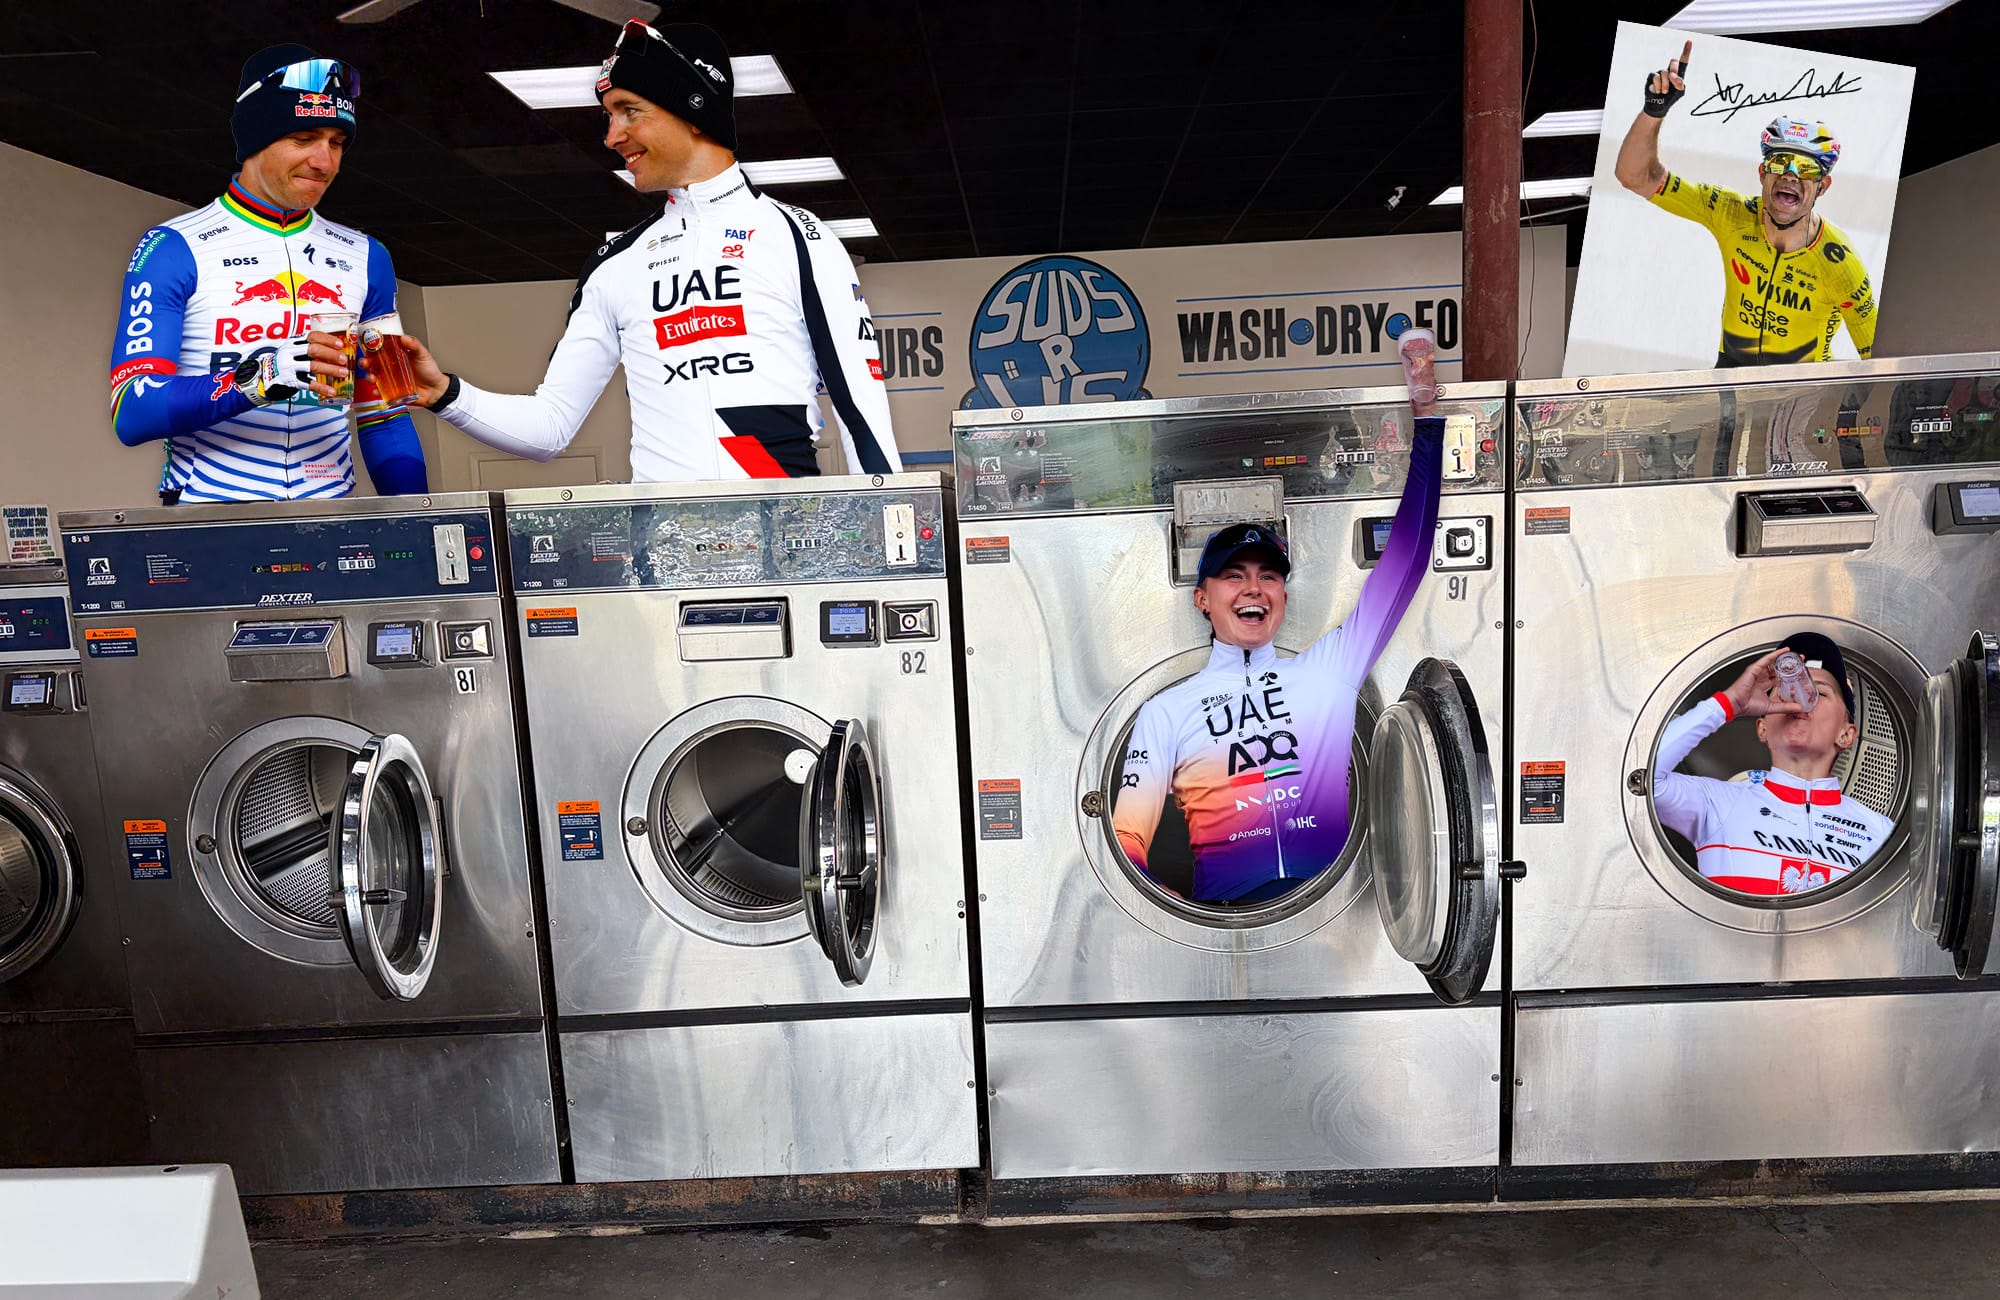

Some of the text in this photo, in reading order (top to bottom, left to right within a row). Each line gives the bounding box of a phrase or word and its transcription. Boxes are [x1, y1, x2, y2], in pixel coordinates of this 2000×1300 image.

[198, 225, 230, 241] grenke
[325, 228, 355, 246] grenke
[725, 229, 747, 241] FAB
[222, 256, 259, 267] BOSS
[652, 265, 742, 312] UAE
[1756, 275, 1812, 312] VISMA
[126, 281, 153, 356] BOSS
[978, 268, 1137, 351] SUDS
[214, 311, 291, 346] Red
[662, 312, 738, 342] Emirates
[1177, 307, 1287, 363] WASH
[1315, 302, 1389, 356] DRY
[663, 352, 755, 386] XRG
[1038, 332, 1083, 385] R
[1768, 461, 1828, 473] DEXTER
[71, 535, 78, 543] 8
[260, 593, 314, 603] DEXTER
[1449, 576, 1468, 601] 91
[902, 651, 927, 675] 82
[457, 669, 476, 693] 81
[1205, 686, 1291, 737] UAE
[1228, 730, 1300, 777] ADQ
[1238, 827, 1272, 840] Analog
[1297, 815, 1318, 830] IHC
[1822, 814, 1866, 832] SRAM
[1753, 830, 1862, 869] CANYON
